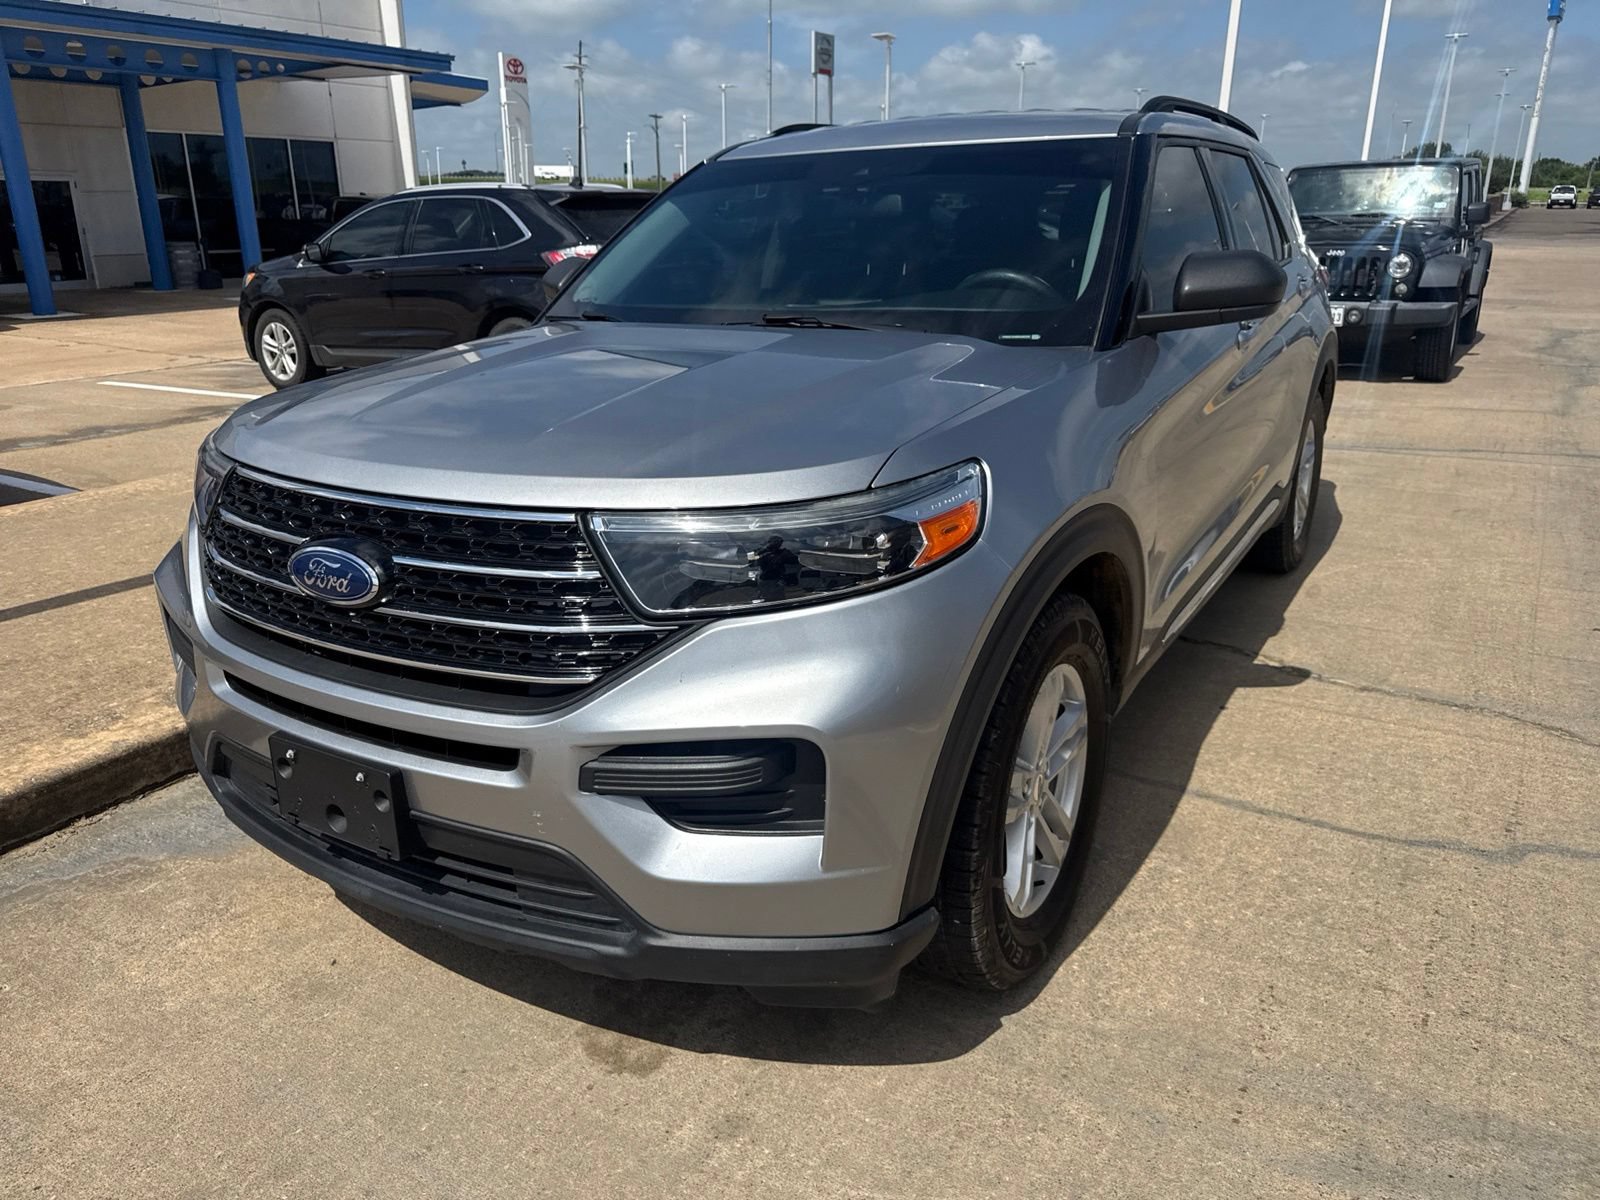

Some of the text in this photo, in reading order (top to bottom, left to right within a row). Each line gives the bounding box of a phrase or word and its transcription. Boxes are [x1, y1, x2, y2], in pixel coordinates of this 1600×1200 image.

[505, 75, 527, 83] TOYOTA
[1326, 249, 1346, 257] Jeep
[304, 557, 352, 593] Ford
